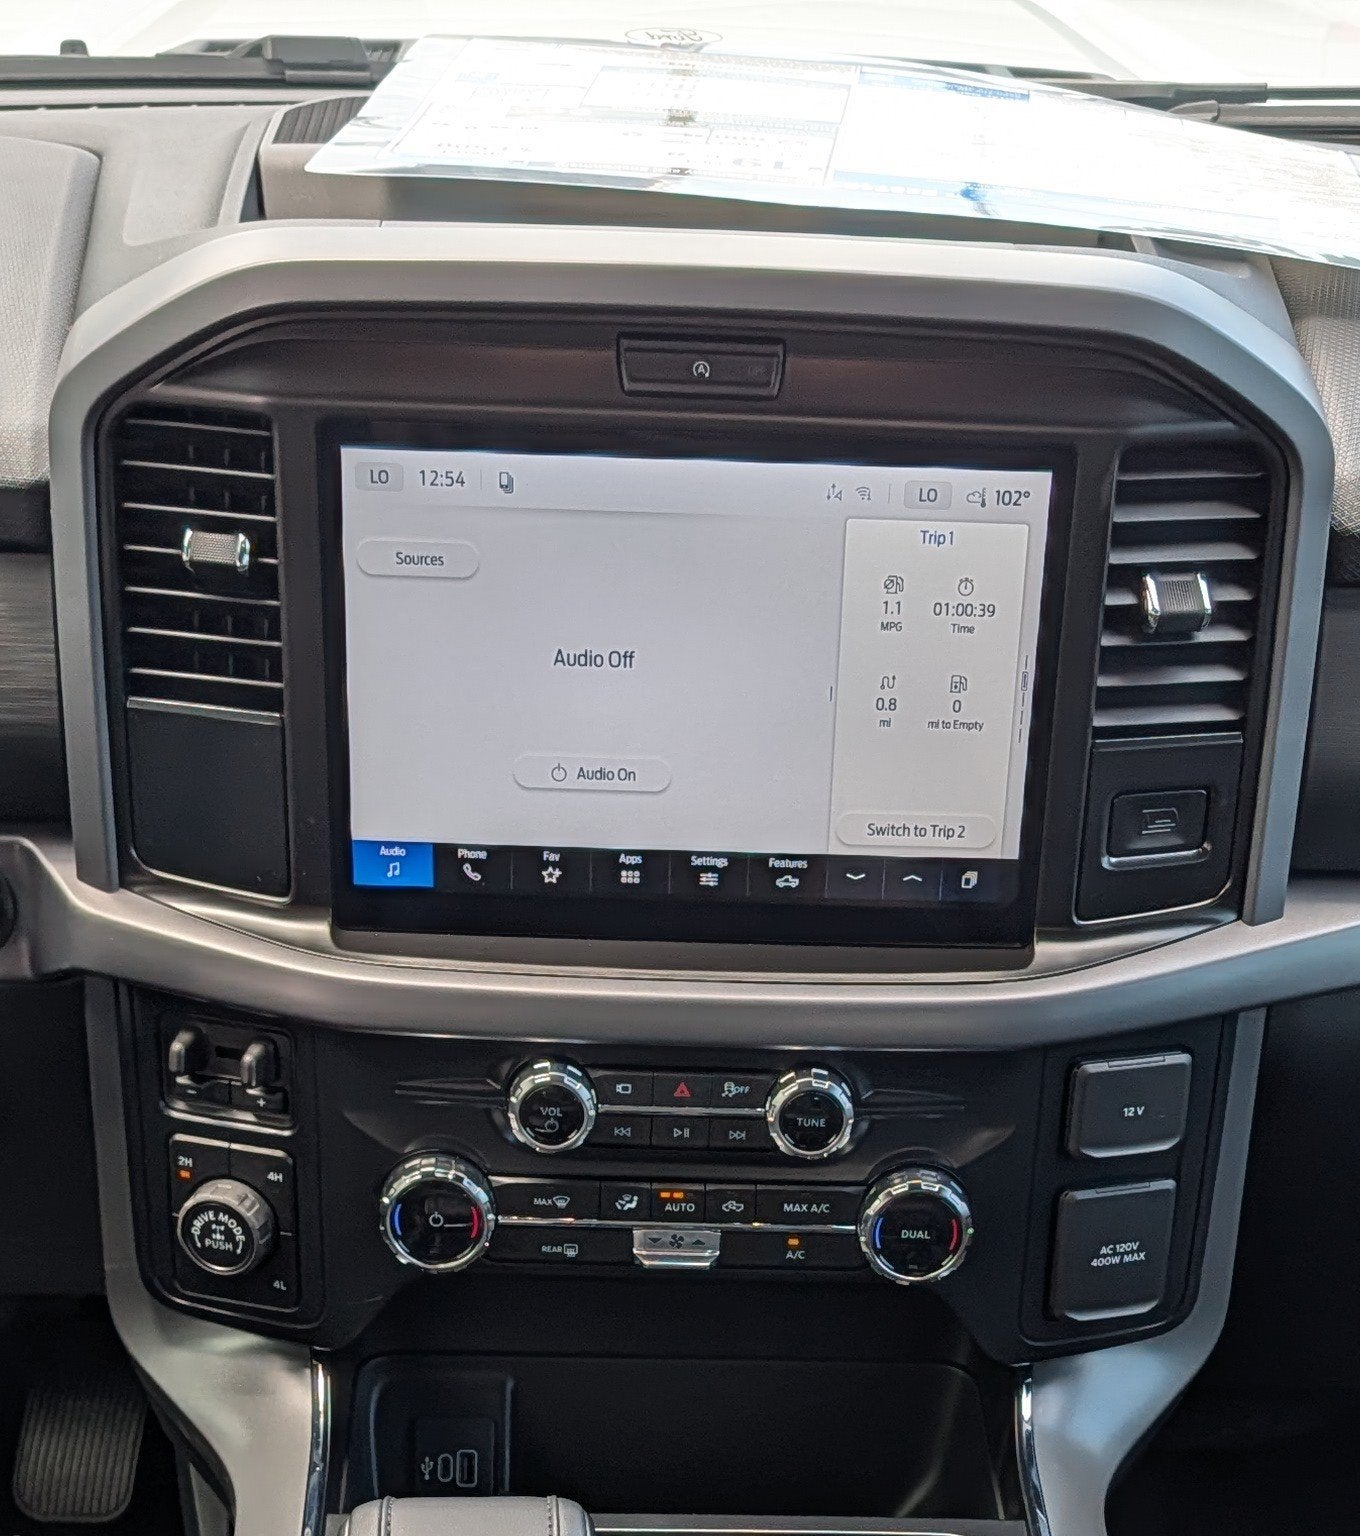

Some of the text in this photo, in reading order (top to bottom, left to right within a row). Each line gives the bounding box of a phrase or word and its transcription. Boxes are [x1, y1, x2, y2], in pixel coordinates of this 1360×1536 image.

[369, 469, 466, 488] LO 12:54
[918, 487, 1031, 507] LO 102°
[920, 530, 954, 547] Trip 1
[395, 551, 445, 567] Sources
[882, 601, 902, 615] 1.1
[933, 602, 996, 618] 01:00:39
[880, 621, 903, 632] MPG
[950, 623, 976, 635] Time
[553, 648, 636, 669] Audio Off
[875, 697, 897, 712] 0.8
[952, 699, 962, 713] 0
[879, 717, 892, 728] mi
[927, 719, 984, 732] mi to Empty
[576, 767, 636, 782] Audio On
[866, 822, 966, 841] Switch to Trip 2
[379, 846, 406, 857] Audio
[457, 848, 488, 861] Phone
[543, 850, 561, 862] Fav
[619, 853, 643, 865] Apps
[690, 855, 729, 869] Settings
[768, 857, 808, 869] Features
[540, 1107, 562, 1117] VOL
[1123, 1106, 1145, 1117] 12 V
[796, 1117, 826, 1128] TUNE
[177, 1156, 193, 1167] 2H
[267, 1172, 283, 1182] 4H
[533, 1197, 553, 1206] MAX
[665, 1202, 695, 1213] AUTO
[783, 1203, 830, 1213] MAX A/C
[191, 1210, 245, 1242] DRIVE MODE
[901, 1229, 931, 1240] DUAL
[205, 1238, 233, 1252] PUSH
[541, 1245, 562, 1254] REAR
[1100, 1241, 1139, 1255] AC 120V
[786, 1250, 805, 1260] A/C
[1091, 1251, 1146, 1267] 400W MAX
[273, 1280, 287, 1291] 4L
